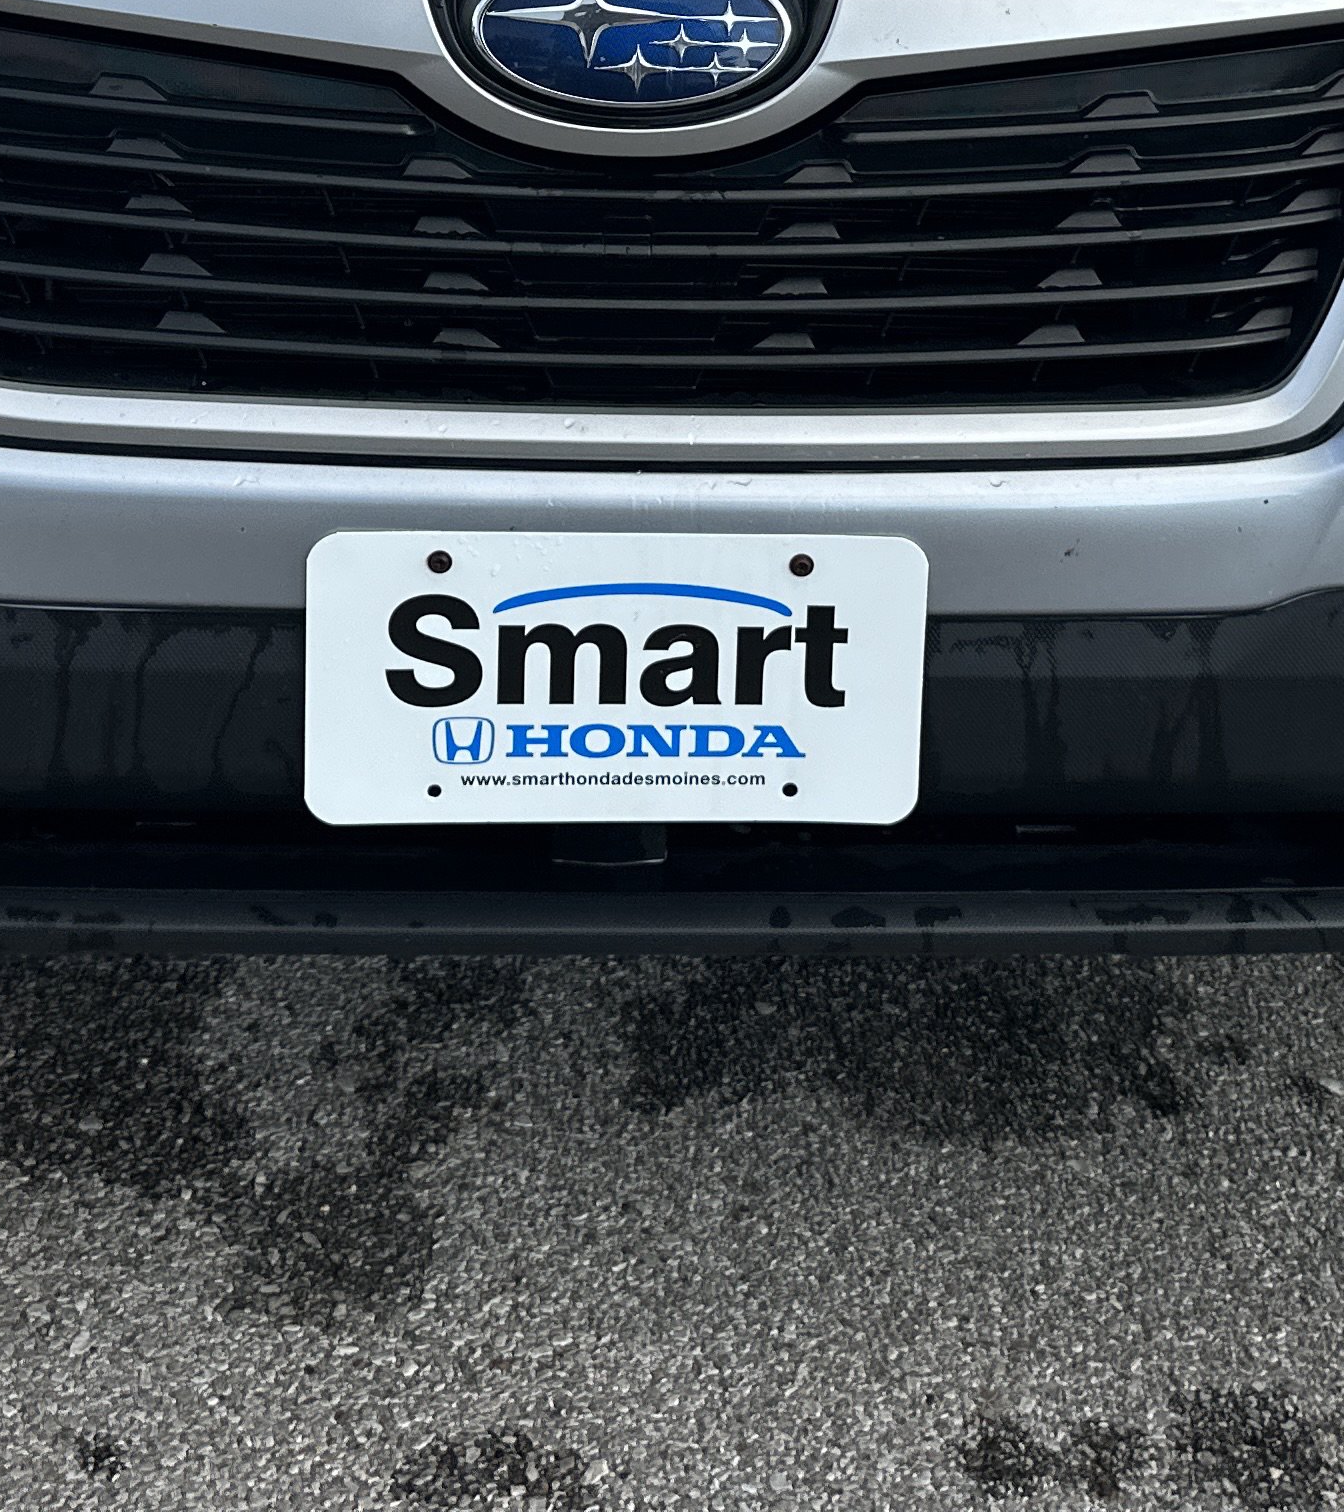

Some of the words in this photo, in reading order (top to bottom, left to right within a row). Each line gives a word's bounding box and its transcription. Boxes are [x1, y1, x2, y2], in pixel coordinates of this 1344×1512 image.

[385, 593, 849, 708] Smart
[506, 723, 806, 759] HONDA
[460, 771, 766, 787] www.smarthondadesmoines.com
